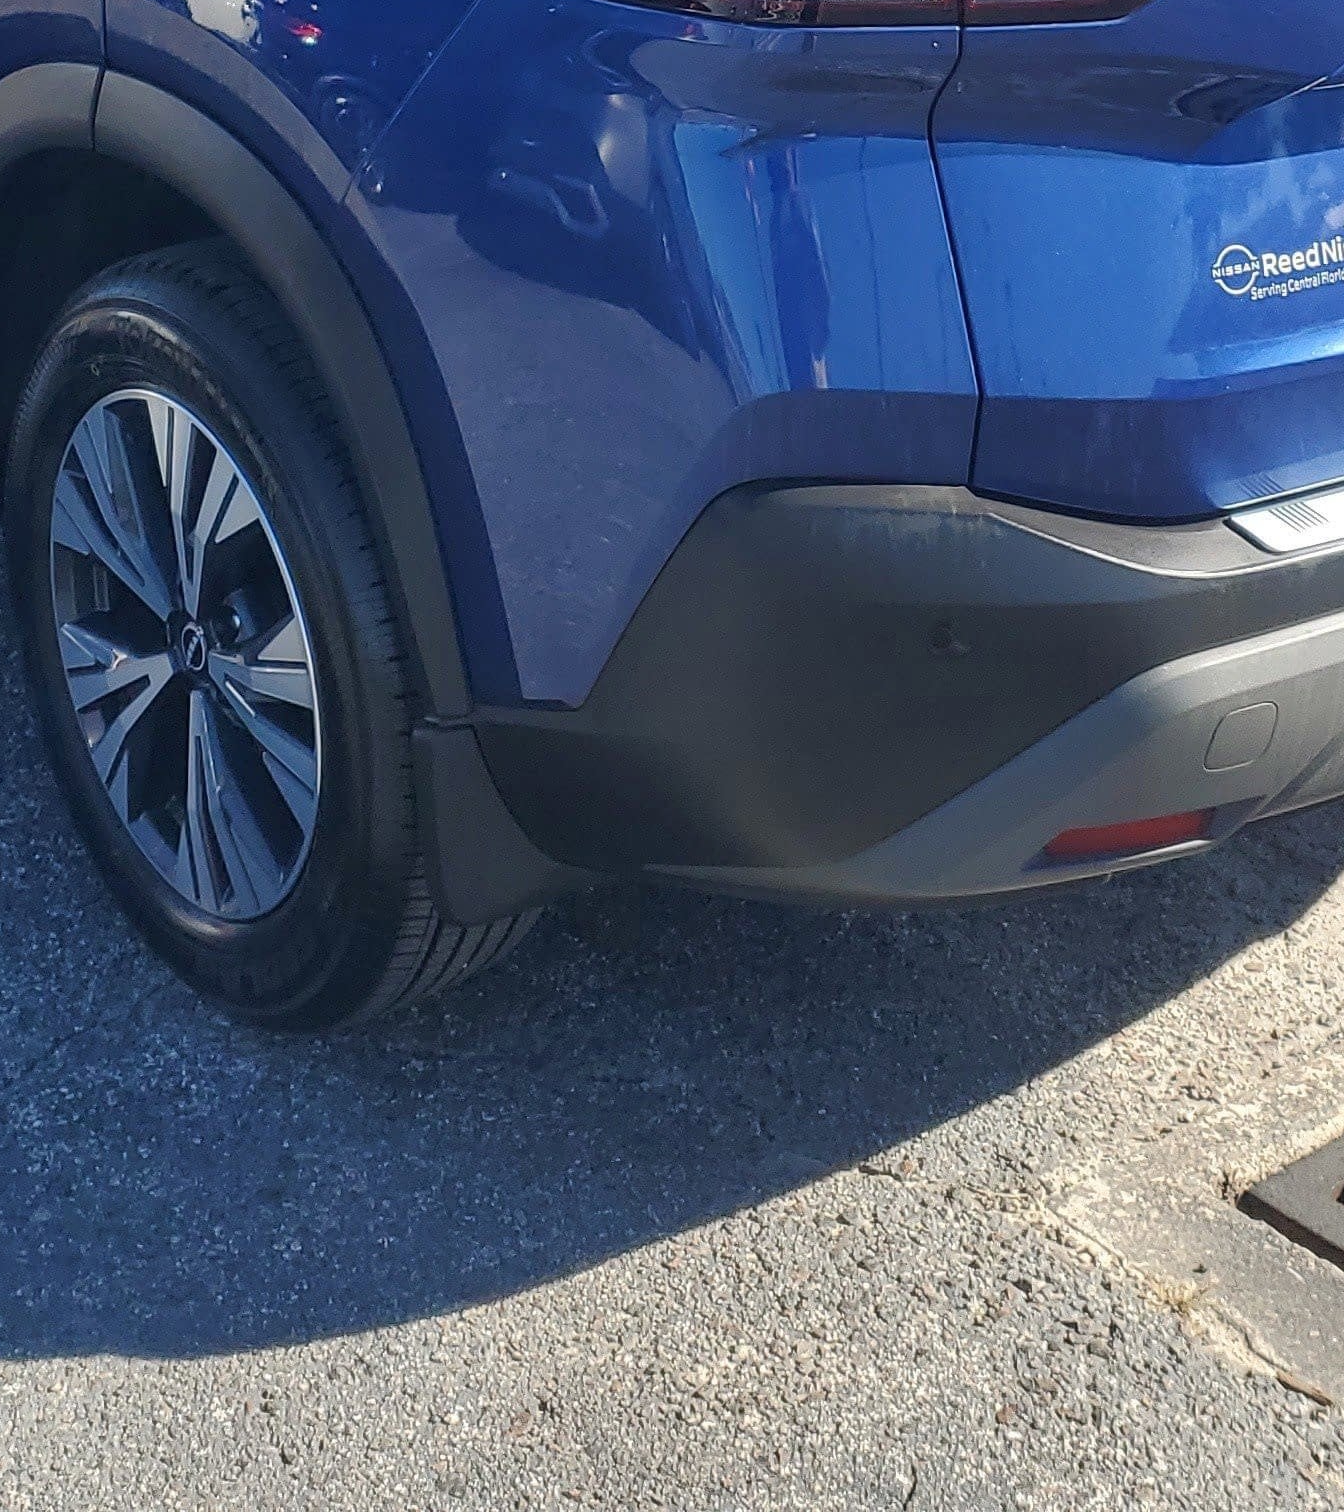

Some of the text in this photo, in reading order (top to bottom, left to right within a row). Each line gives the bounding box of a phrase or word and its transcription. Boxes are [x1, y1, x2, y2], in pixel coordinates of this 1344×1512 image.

[1212, 261, 1260, 278] NISSAN
[1250, 283, 1287, 300] Serving
[1288, 275, 1321, 293] Central
